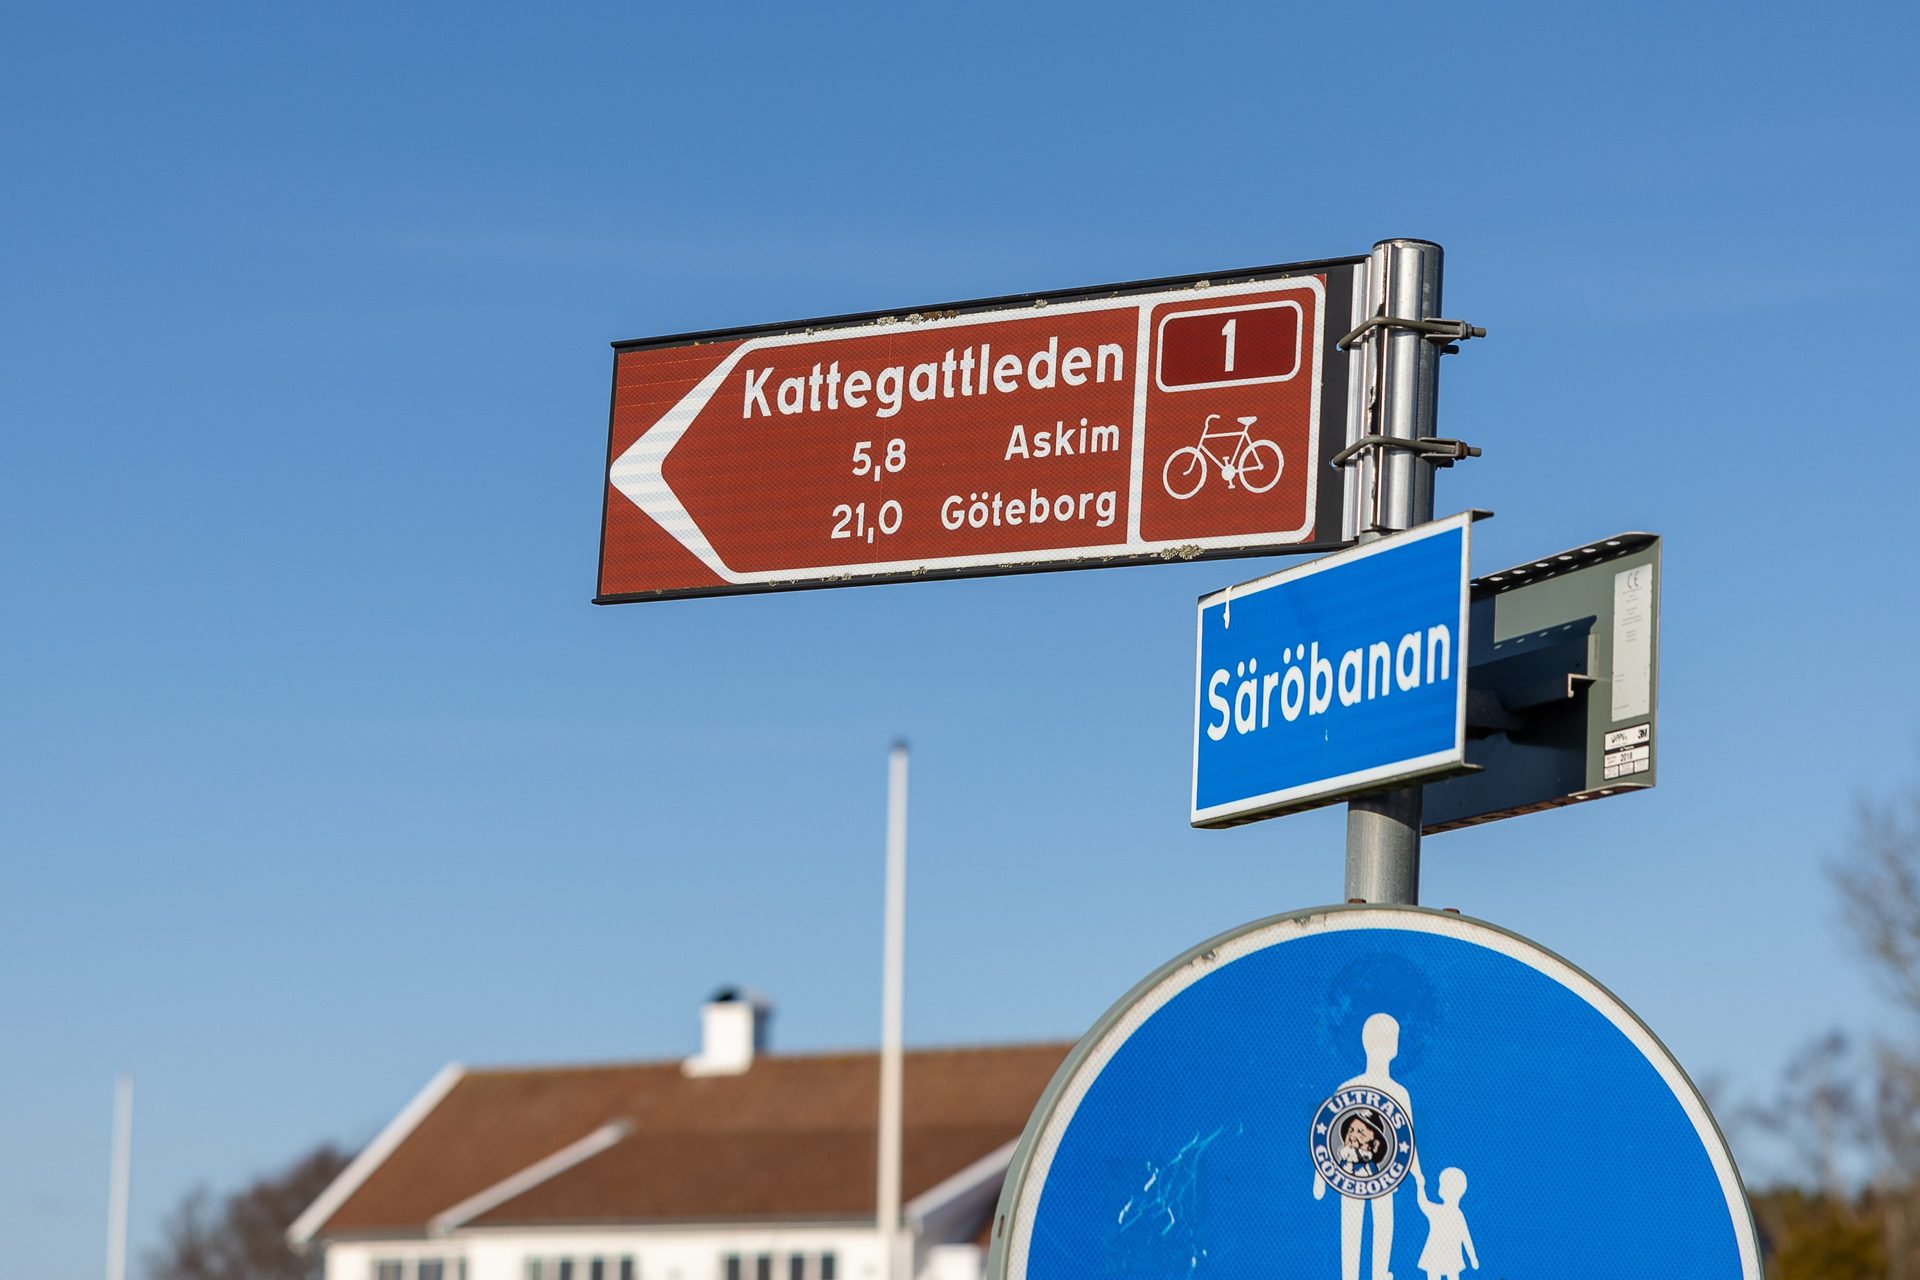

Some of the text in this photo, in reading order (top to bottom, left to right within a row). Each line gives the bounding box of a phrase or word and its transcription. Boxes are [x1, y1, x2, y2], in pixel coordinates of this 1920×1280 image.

[1221, 318, 1237, 372] 1
[743, 343, 1124, 419] Kattegattleden
[852, 420, 1120, 482] 5,8 Askim
[830, 488, 1117, 544] 21,0 Göteborg
[1207, 624, 1450, 741] Säröbanan
[1327, 1091, 1406, 1129] ULTRAS
